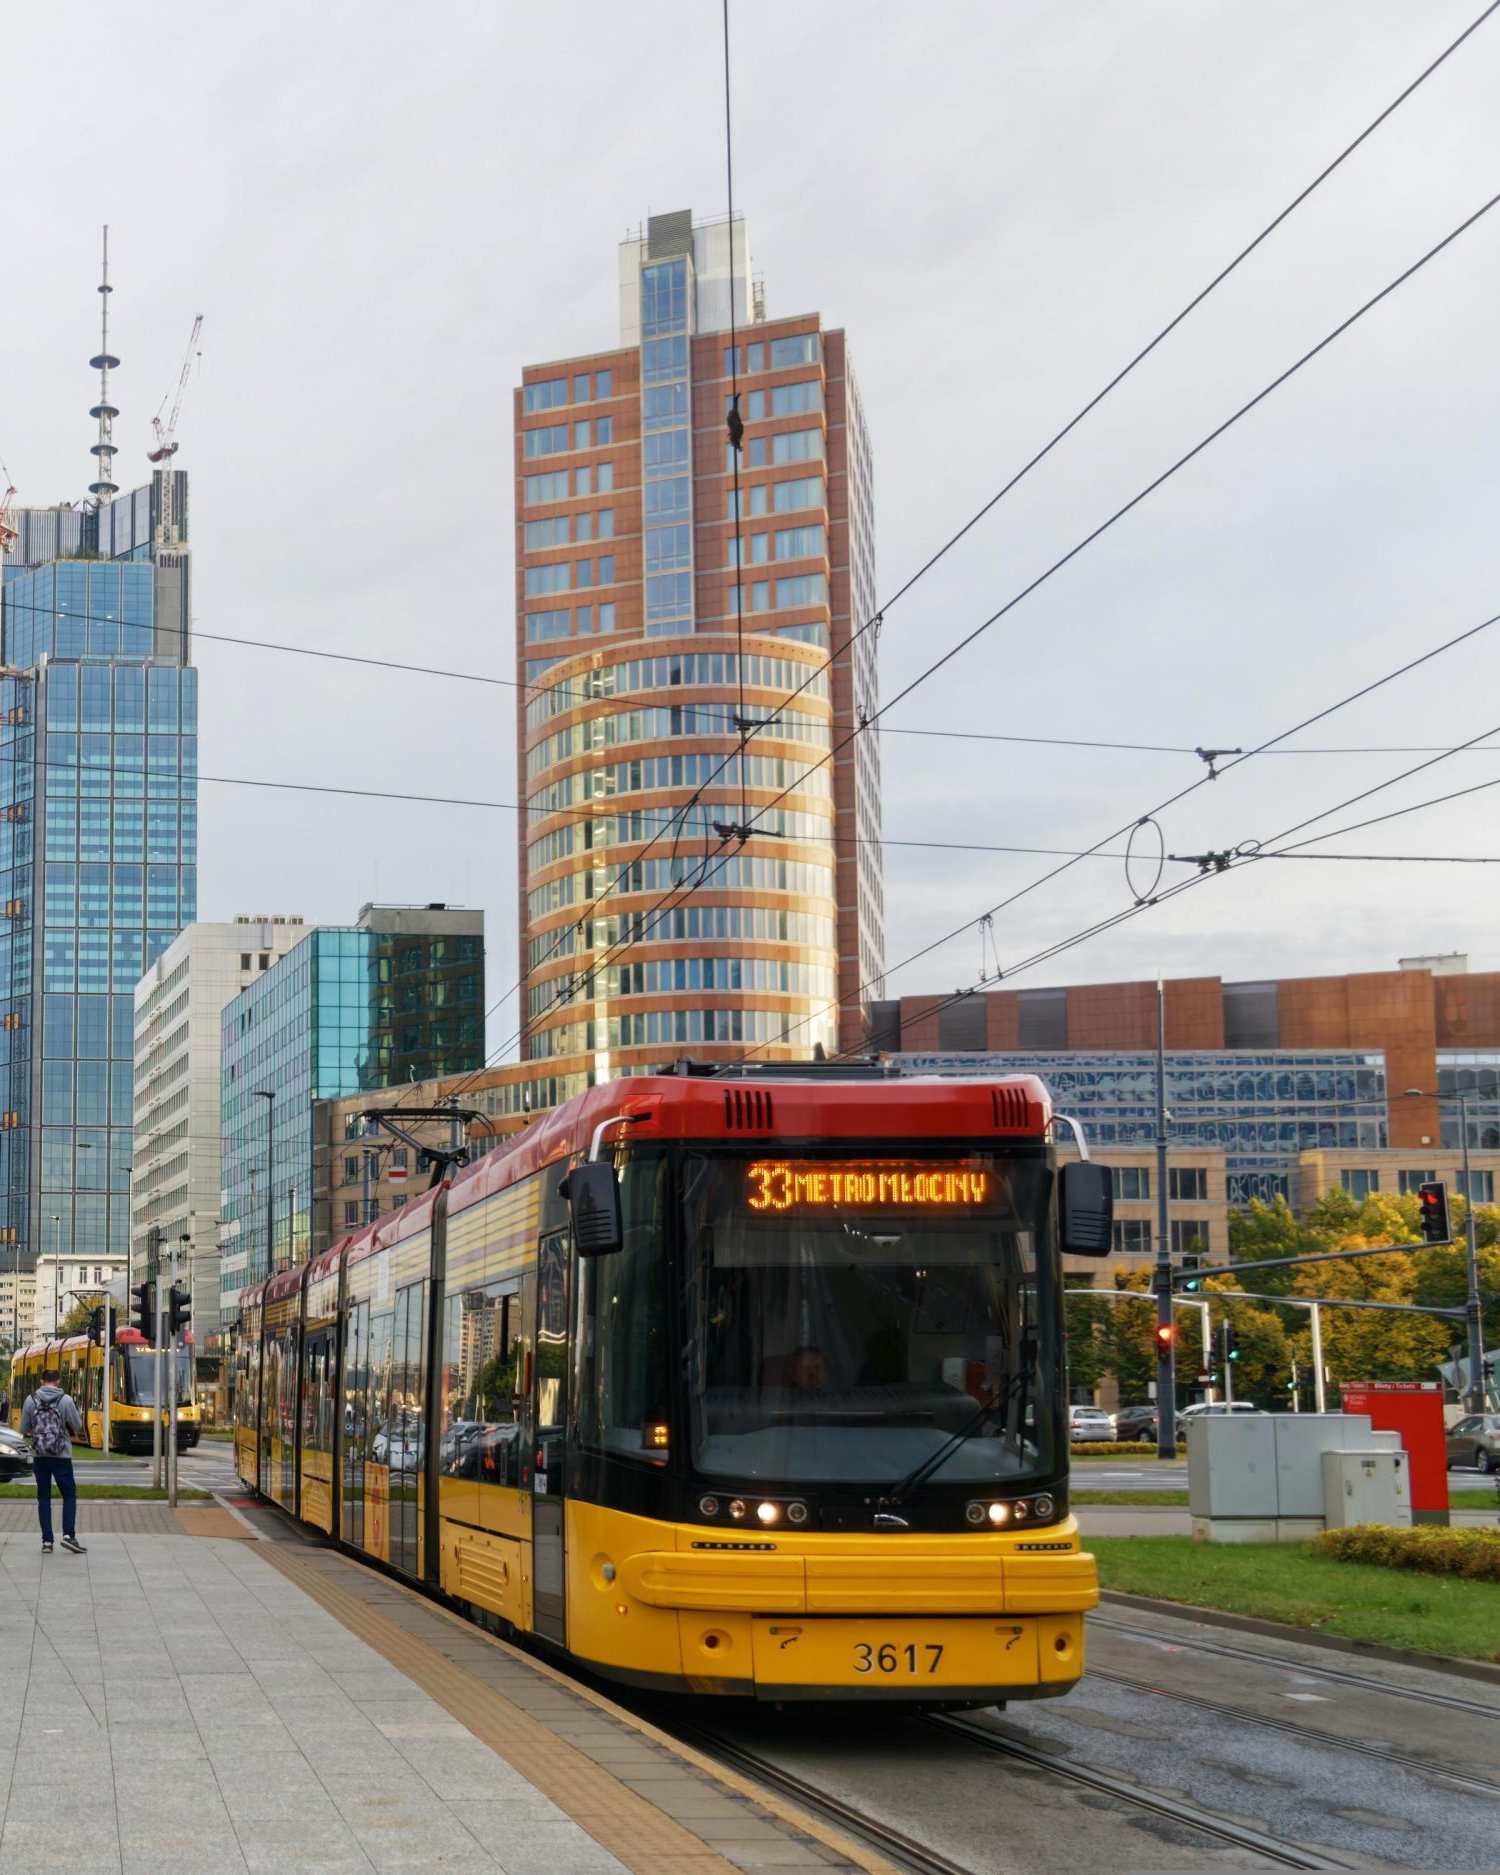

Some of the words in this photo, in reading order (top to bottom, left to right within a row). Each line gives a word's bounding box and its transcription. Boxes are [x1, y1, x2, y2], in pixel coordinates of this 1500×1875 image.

[748, 1167, 791, 1208] 33
[795, 1174, 875, 1202] METRO
[879, 1174, 986, 1202] MŁOCINY
[853, 1643, 944, 1673] 3617
